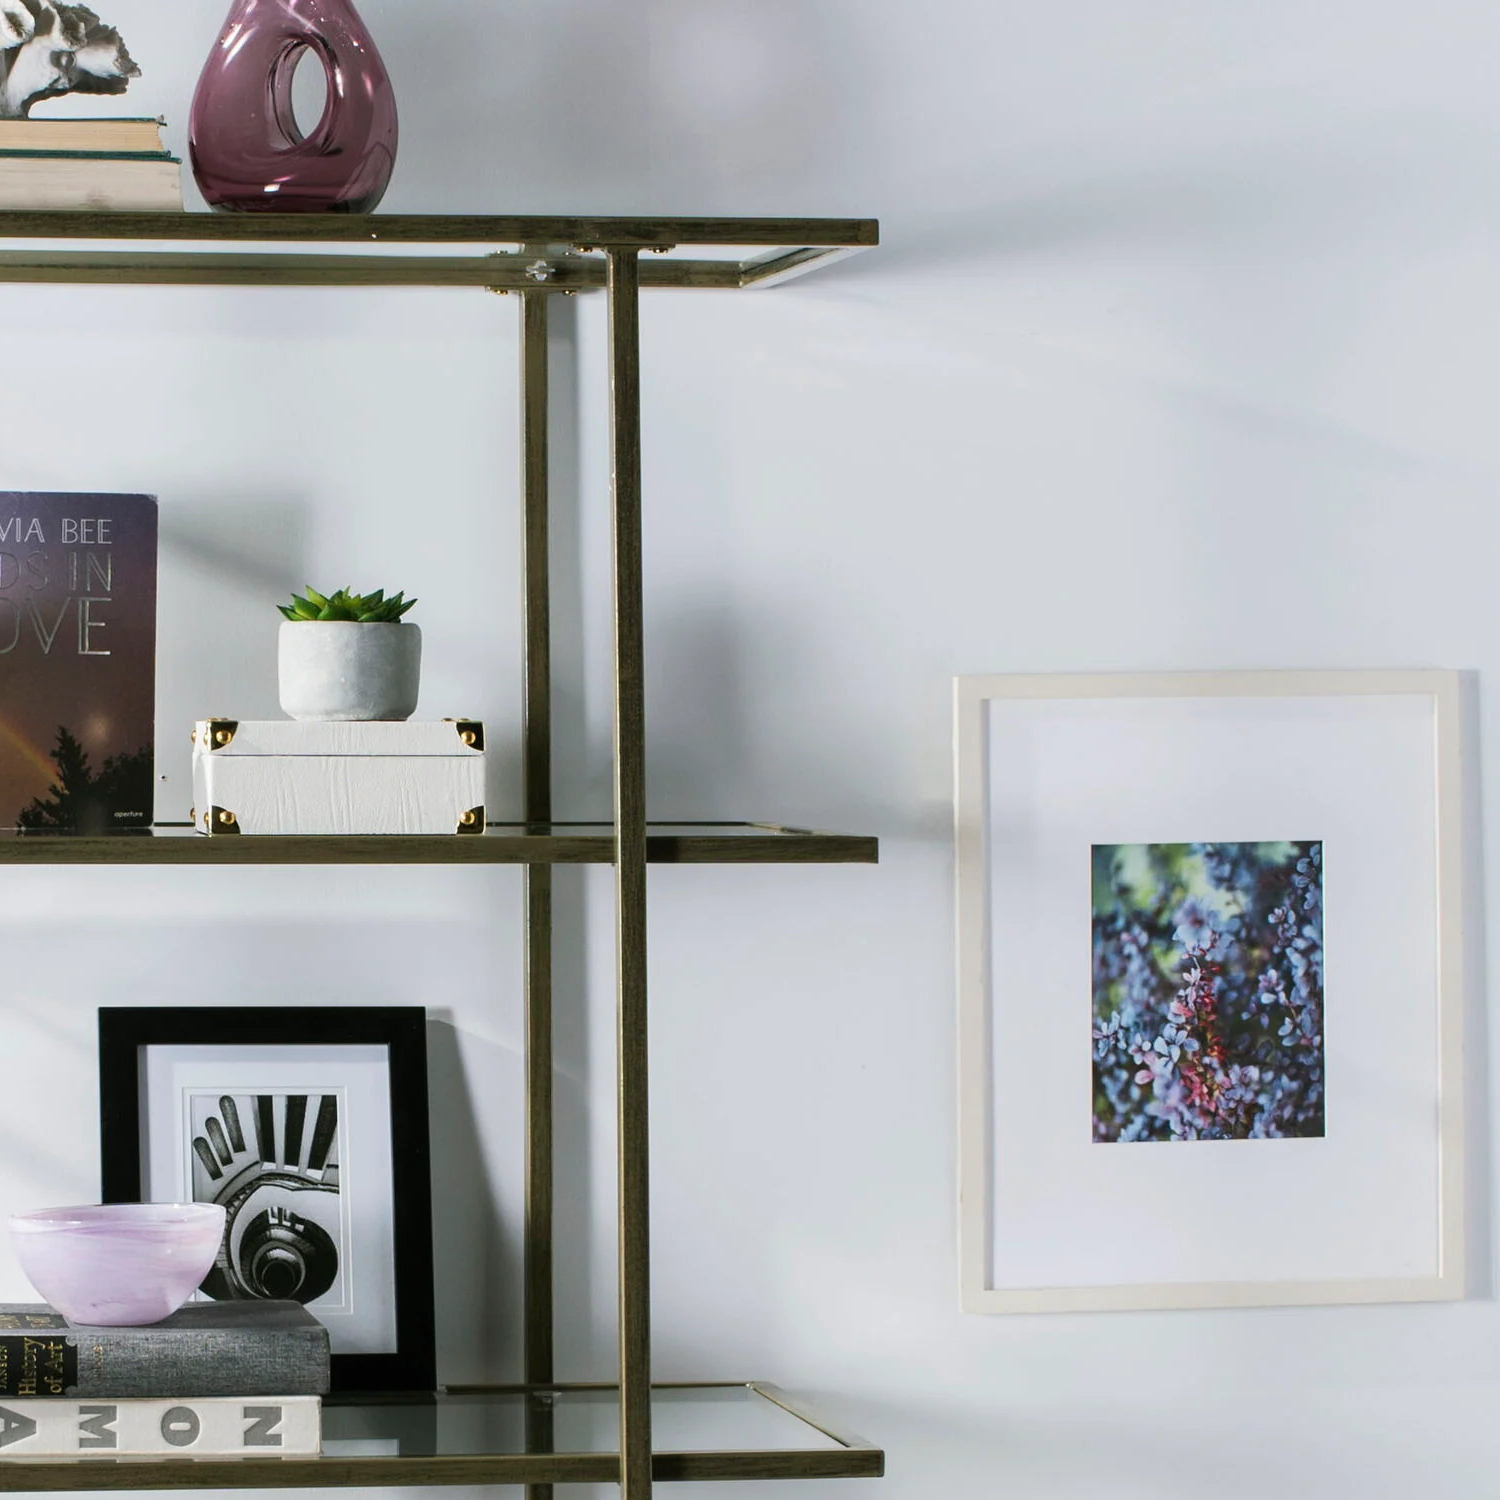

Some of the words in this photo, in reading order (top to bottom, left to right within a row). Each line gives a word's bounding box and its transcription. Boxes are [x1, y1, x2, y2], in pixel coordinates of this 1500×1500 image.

[61, 518, 113, 545] BEE
[68, 551, 113, 592] IN
[114, 810, 144, 819] aperture
[18, 1336, 45, 1396] History
[44, 1340, 64, 1374] Art
[45, 1374, 63, 1394] of
[0, 1405, 283, 1449] NOMA
